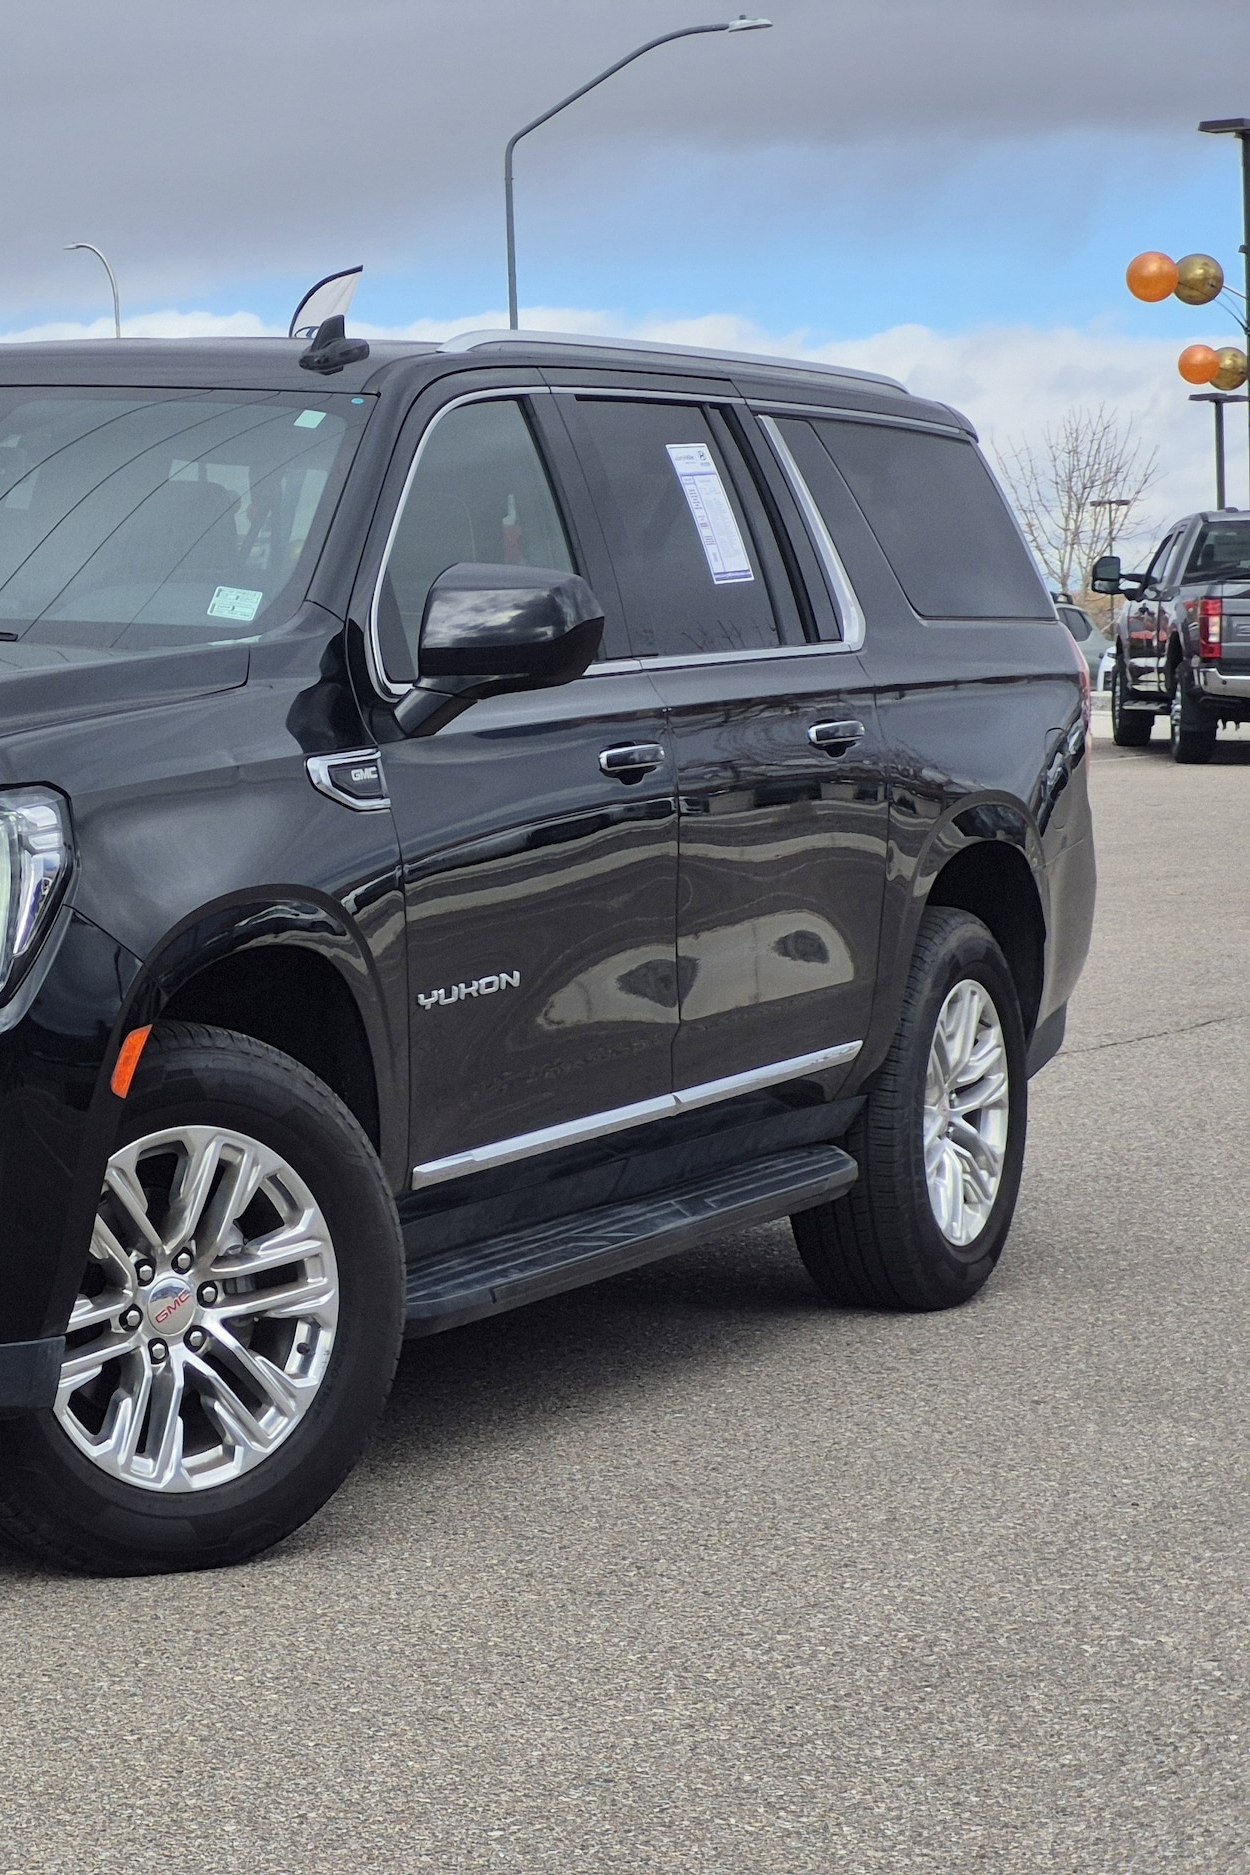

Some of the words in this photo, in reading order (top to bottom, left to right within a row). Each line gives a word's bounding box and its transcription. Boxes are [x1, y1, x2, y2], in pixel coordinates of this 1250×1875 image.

[350, 766, 379, 782] GMC
[417, 970, 521, 1010] YUKON
[155, 1289, 190, 1324] GMC
